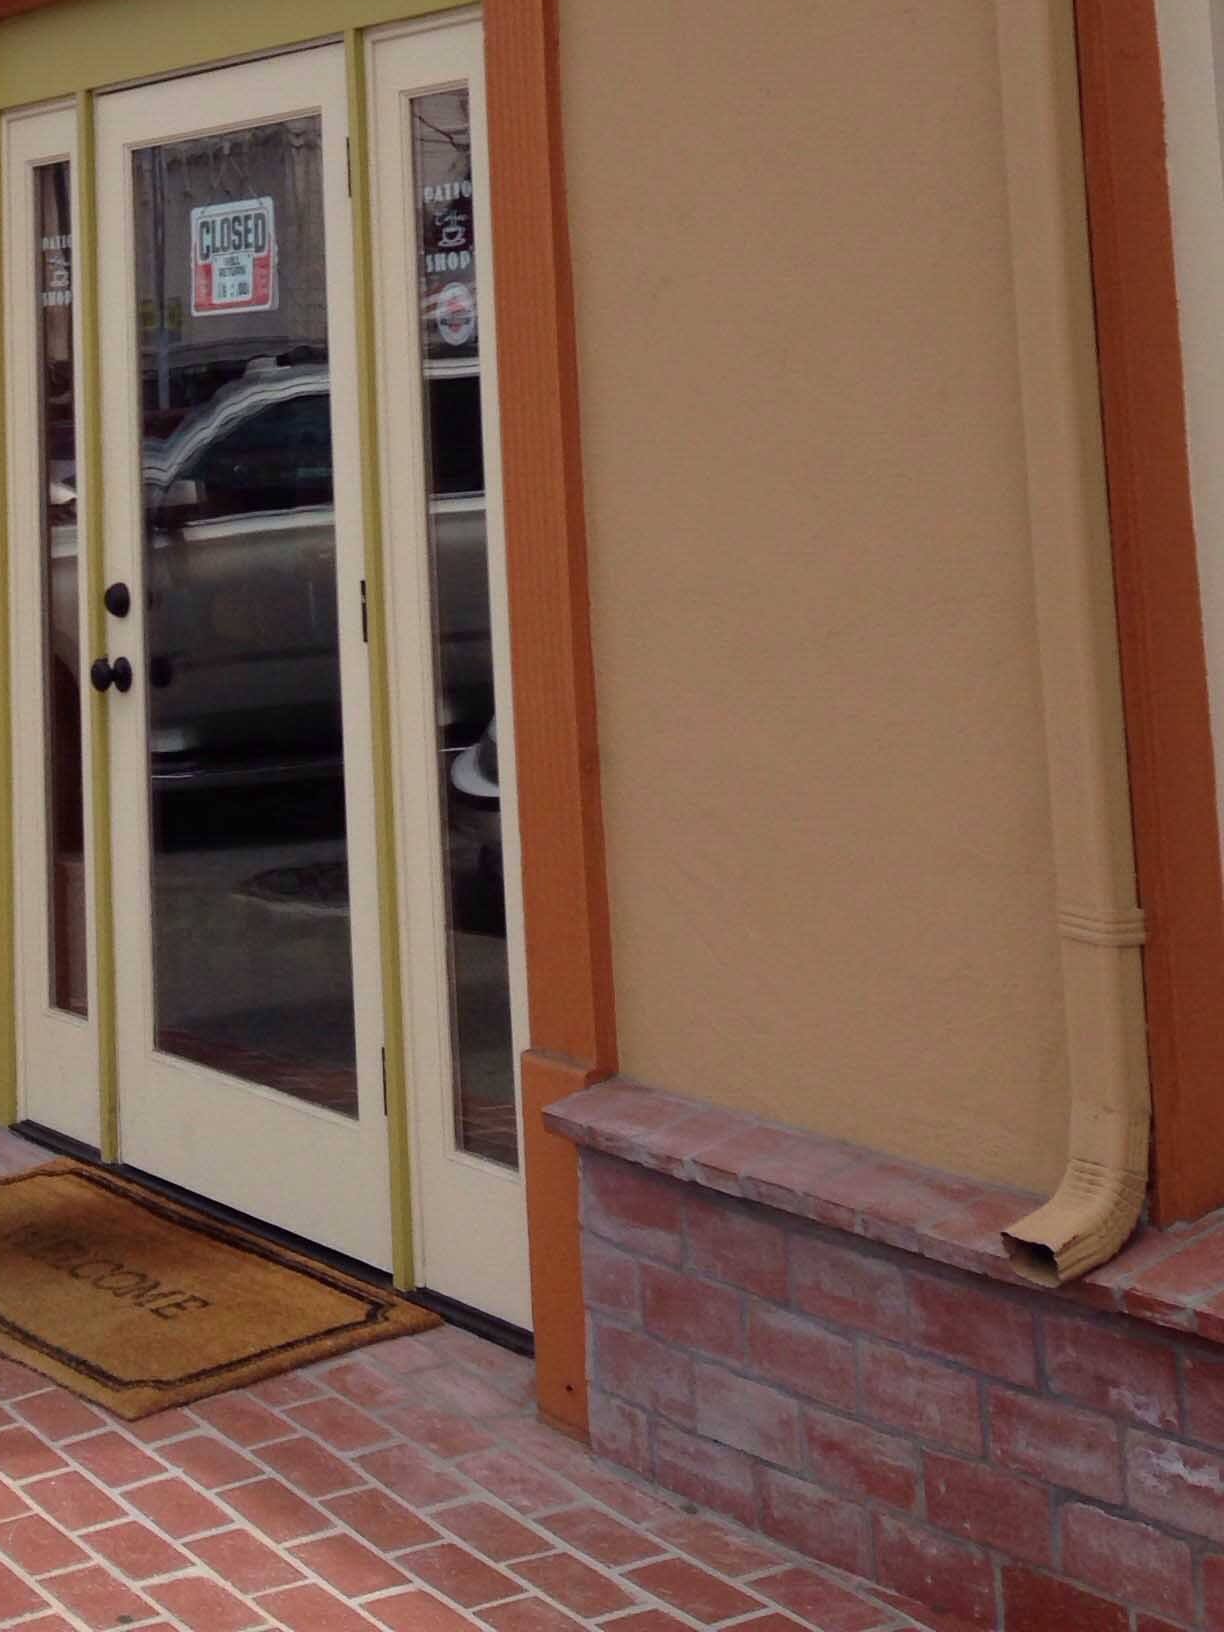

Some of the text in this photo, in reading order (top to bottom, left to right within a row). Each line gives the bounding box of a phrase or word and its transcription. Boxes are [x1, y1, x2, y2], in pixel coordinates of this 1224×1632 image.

[424, 180, 473, 203] PATIO
[199, 213, 267, 261] CLOSED
[427, 250, 471, 272] SHOP
